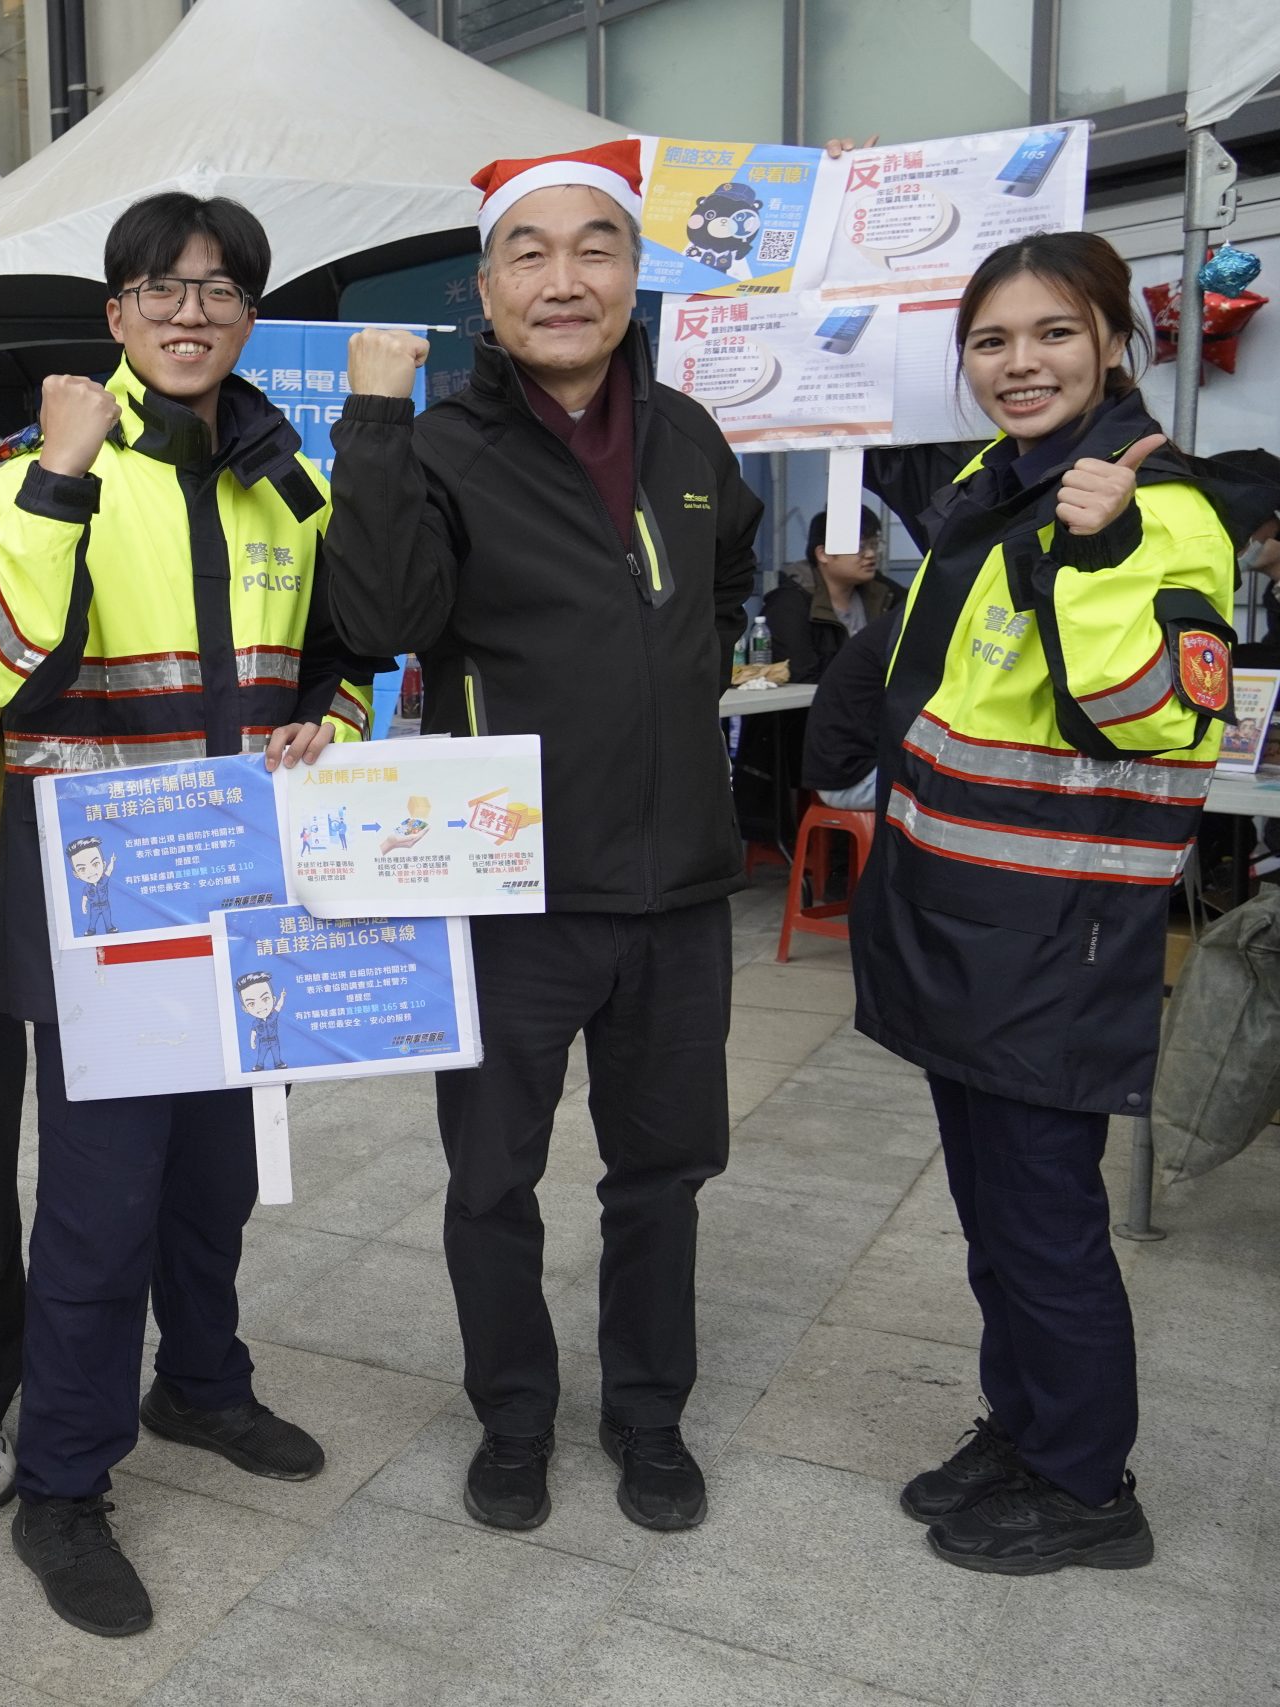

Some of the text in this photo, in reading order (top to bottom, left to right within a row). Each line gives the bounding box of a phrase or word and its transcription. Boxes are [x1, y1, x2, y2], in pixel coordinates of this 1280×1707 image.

[665, 146, 735, 166] 網路交友
[1021, 150, 1046, 160] 165
[845, 150, 923, 192] 反詐騙
[675, 303, 748, 342] 反詐騙
[837, 307, 862, 318] 165
[427, 369, 471, 399] 電站
[245, 542, 294, 566] 警察
[242, 572, 301, 593] POLICE
[984, 605, 1029, 639] 警察
[109, 770, 216, 800] 遇到詐騙問題
[303, 766, 399, 785] 人頭帳戶詐騙
[85, 786, 243, 822] 請直接洽詢165專線
[175, 855, 200, 867] 提醒您
[211, 864, 226, 874] 165
[228, 863, 237, 872] 或
[238, 861, 254, 871] 110
[256, 924, 416, 957] 請直接洽詢165專線
[346, 992, 371, 1003] 提醒您
[382, 1002, 398, 1012] 165
[399, 1001, 409, 1010] 或
[410, 999, 426, 1009] 110
